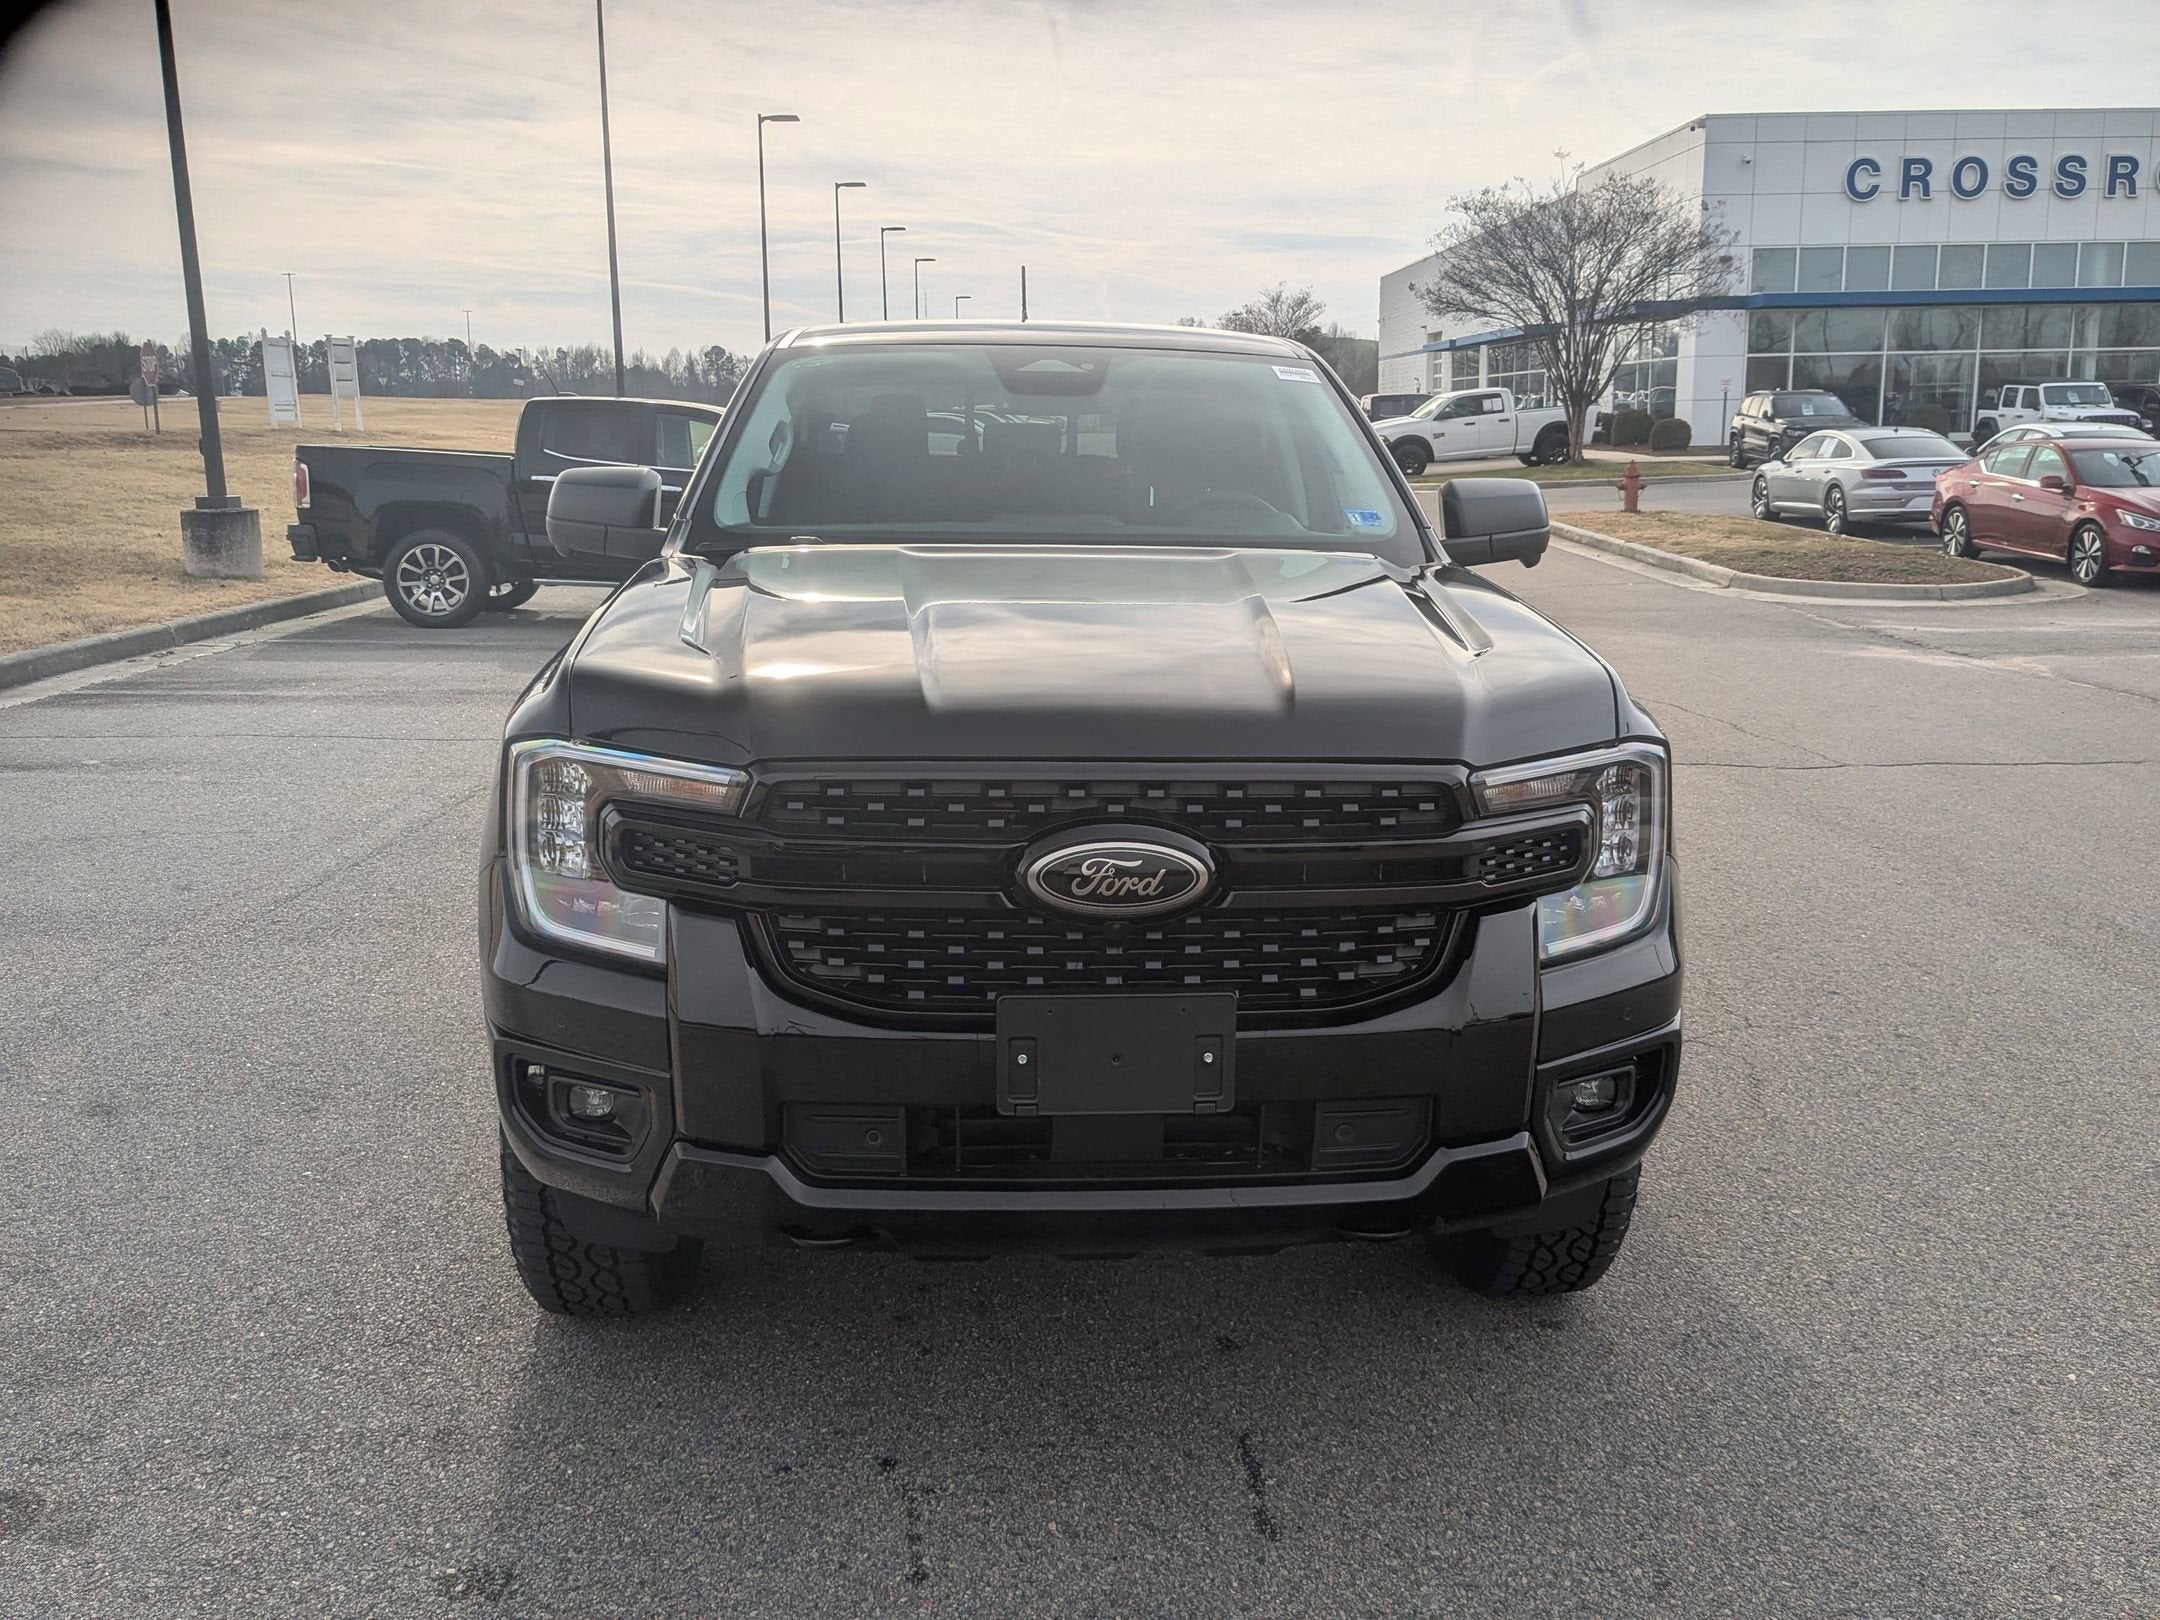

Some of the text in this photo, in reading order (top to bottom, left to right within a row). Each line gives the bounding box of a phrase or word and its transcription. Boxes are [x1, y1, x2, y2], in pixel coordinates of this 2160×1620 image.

[1845, 154, 2160, 201] CROSSR
[141, 355, 158, 372] STOP
[1071, 857, 1167, 896] Ford
